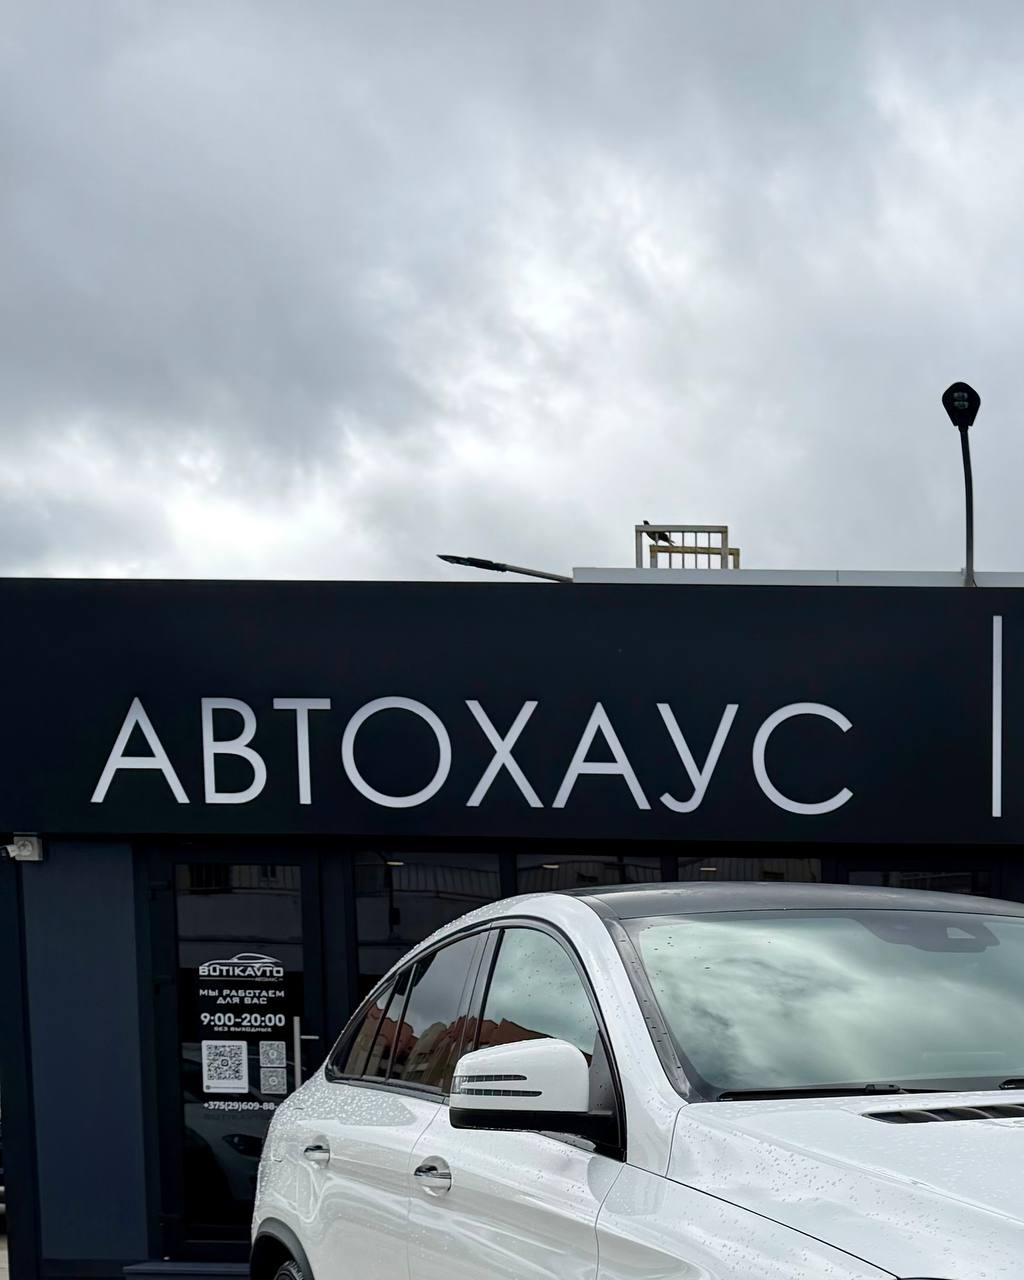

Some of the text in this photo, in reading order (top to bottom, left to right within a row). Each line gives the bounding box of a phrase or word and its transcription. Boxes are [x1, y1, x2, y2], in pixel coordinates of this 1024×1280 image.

[91, 696, 854, 815] АВТОХАУС
[199, 965, 284, 977] BUTIKAVTO
[199, 989, 285, 998] МЫ РАБОТАЕМ
[216, 997, 268, 1005] ДЛЯ ВАС
[200, 1013, 285, 1026] 9:00-20:00
